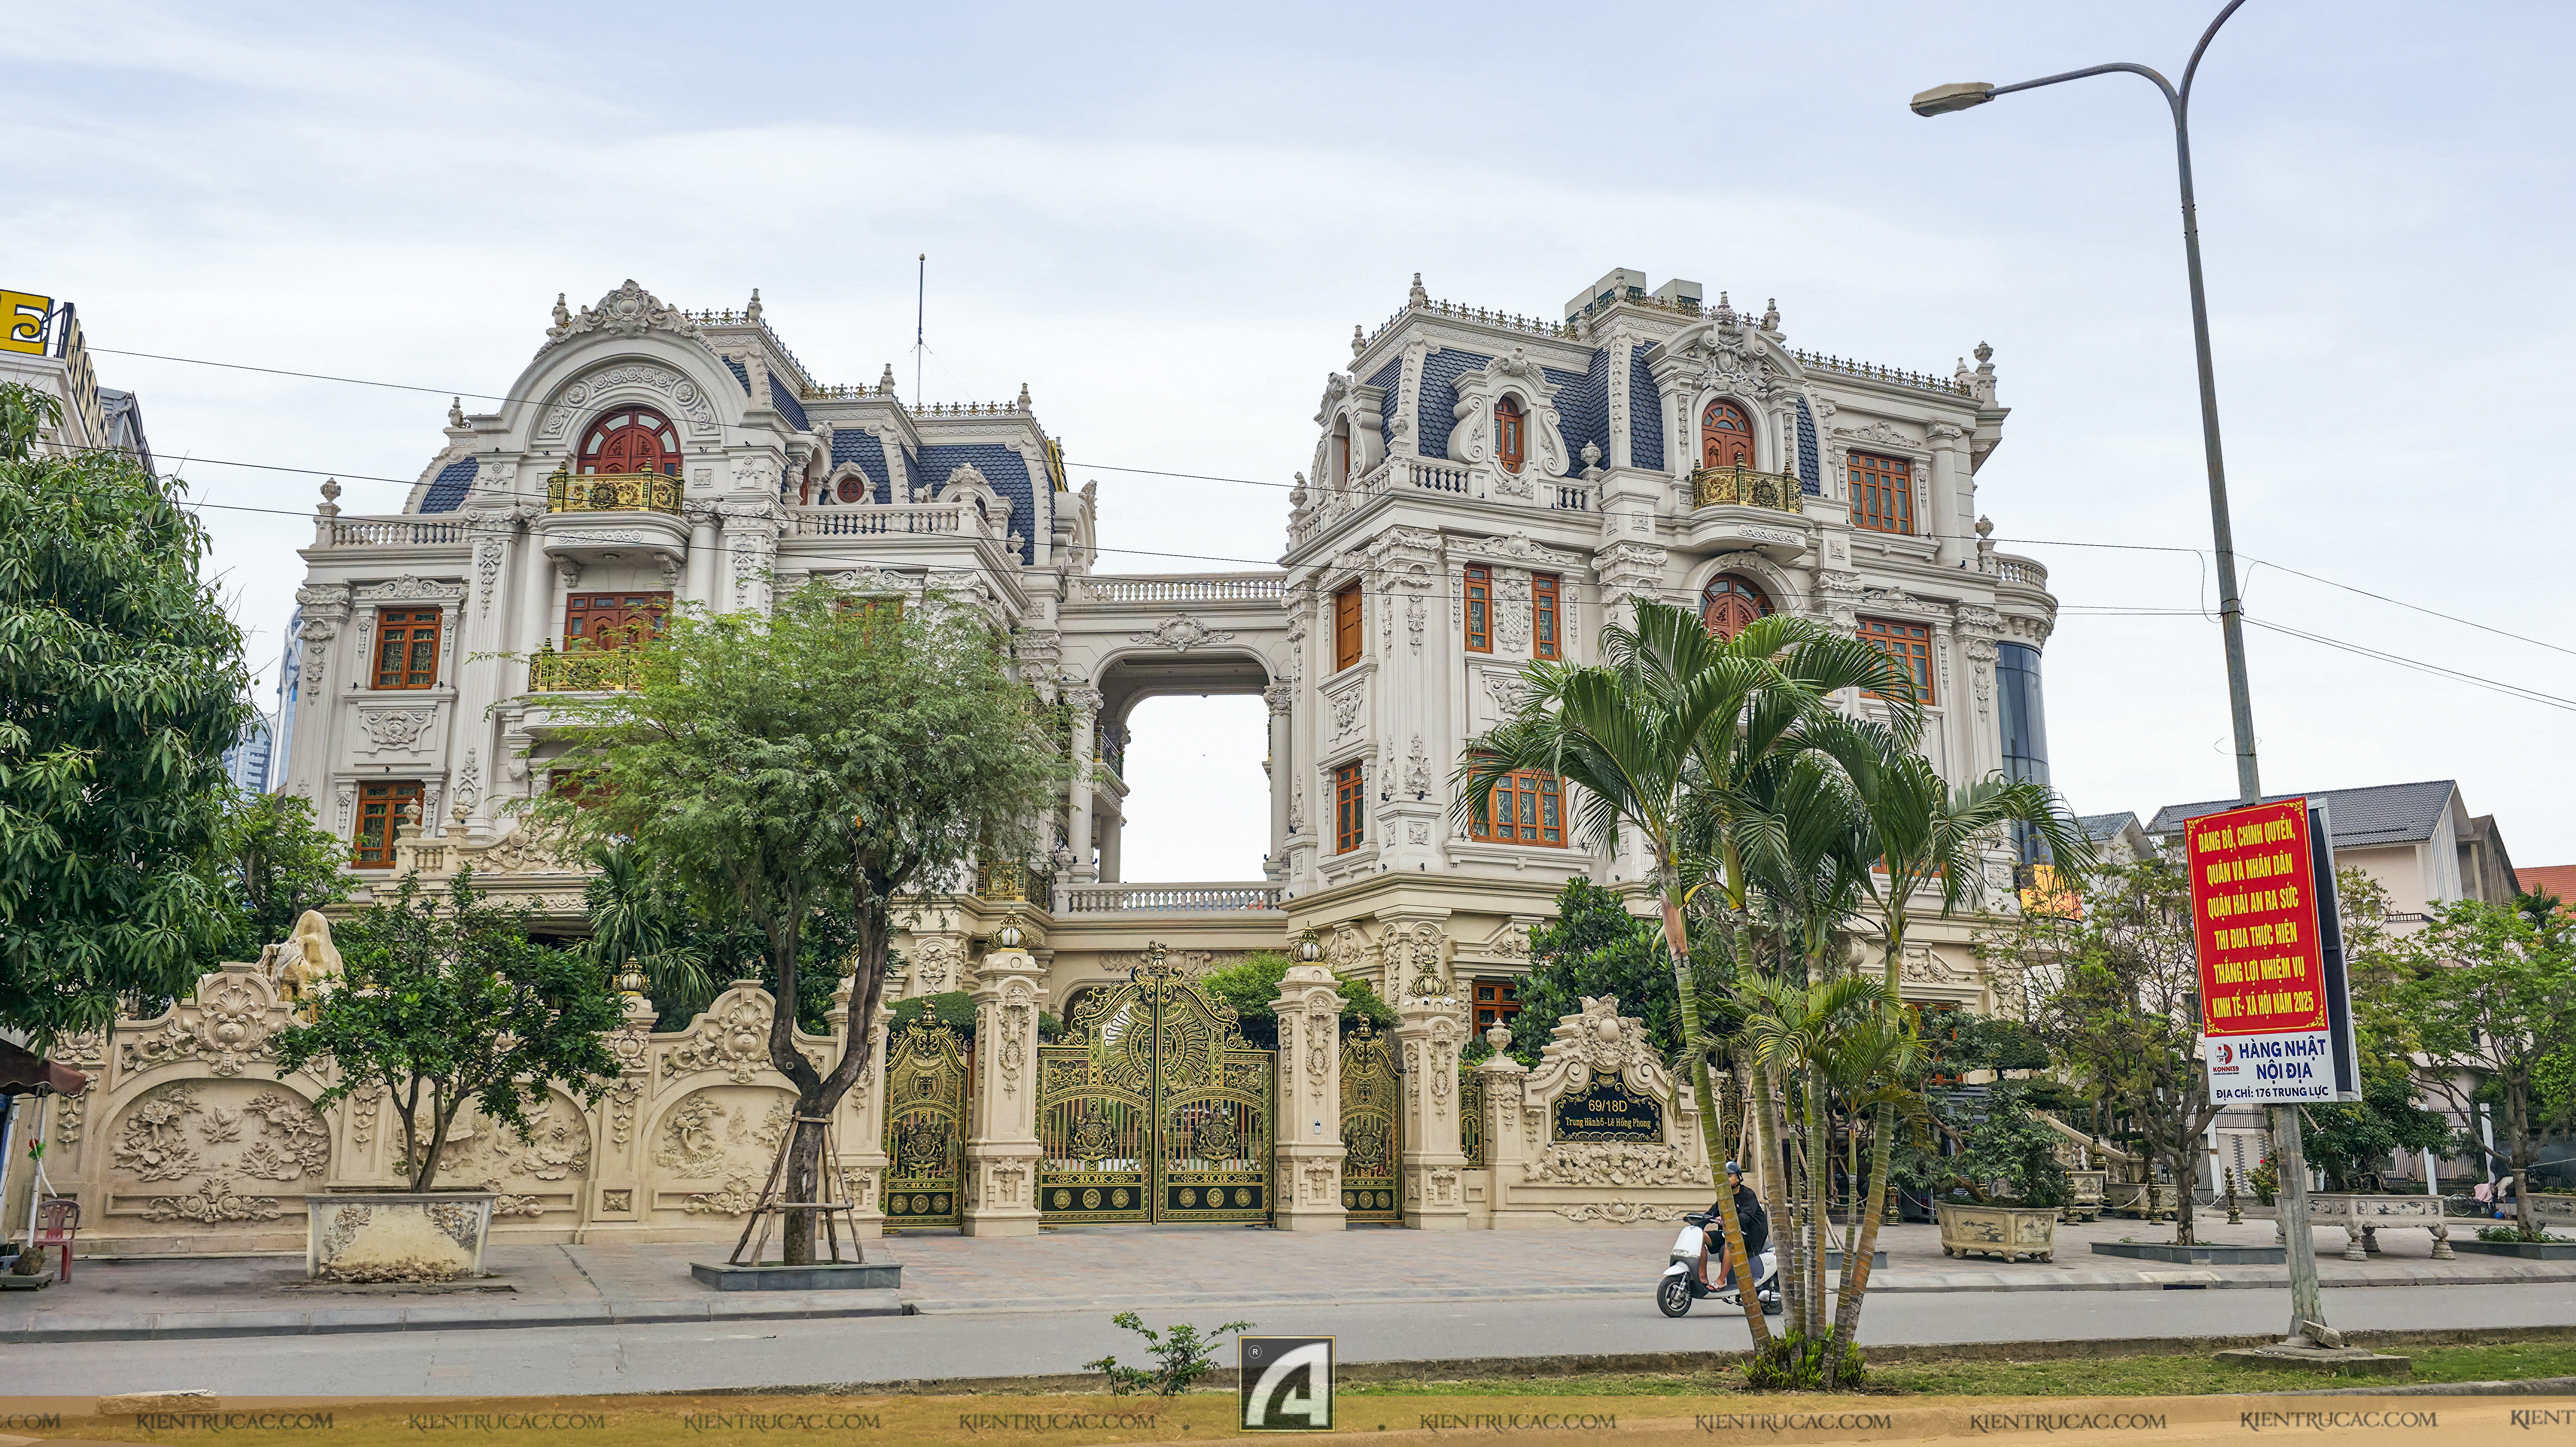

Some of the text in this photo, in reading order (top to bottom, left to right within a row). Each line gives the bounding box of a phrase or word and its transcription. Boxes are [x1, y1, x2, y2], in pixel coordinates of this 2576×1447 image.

[2198, 812, 2295, 853] ĐẢNG BỘ, CHÍNH QUYỀN,
[2207, 850, 2293, 887] QUÂN VÀ NHÂN DÂN
[2207, 882, 2298, 920] QUẬN HẢI AN RA SỨC
[2214, 918, 2297, 950] THI ĐUA THỰC HIỆN
[2213, 954, 2305, 986] THẮNG LỢI NHIỆM VỤ
[2212, 997, 2231, 1018] KINH
[2245, 991, 2257, 1016] XÃ
[2258, 990, 2272, 1019] HỘI
[2273, 988, 2292, 1013] NĂM
[2294, 991, 2314, 1012] 2025
[2239, 1035, 2325, 1061] HÀNG NHẬT
[2256, 1059, 2312, 1084] NỘI ĐỊA
[1588, 1100, 1627, 1112] 69/18D
[2216, 1085, 2328, 1101] ĐỊA CHỈ: 176 TRUNG LỰC
[1566, 1117, 1583, 1128] Trung
[1616, 1117, 1631, 1129] Hồng
[1633, 1118, 1651, 1129] Phong
